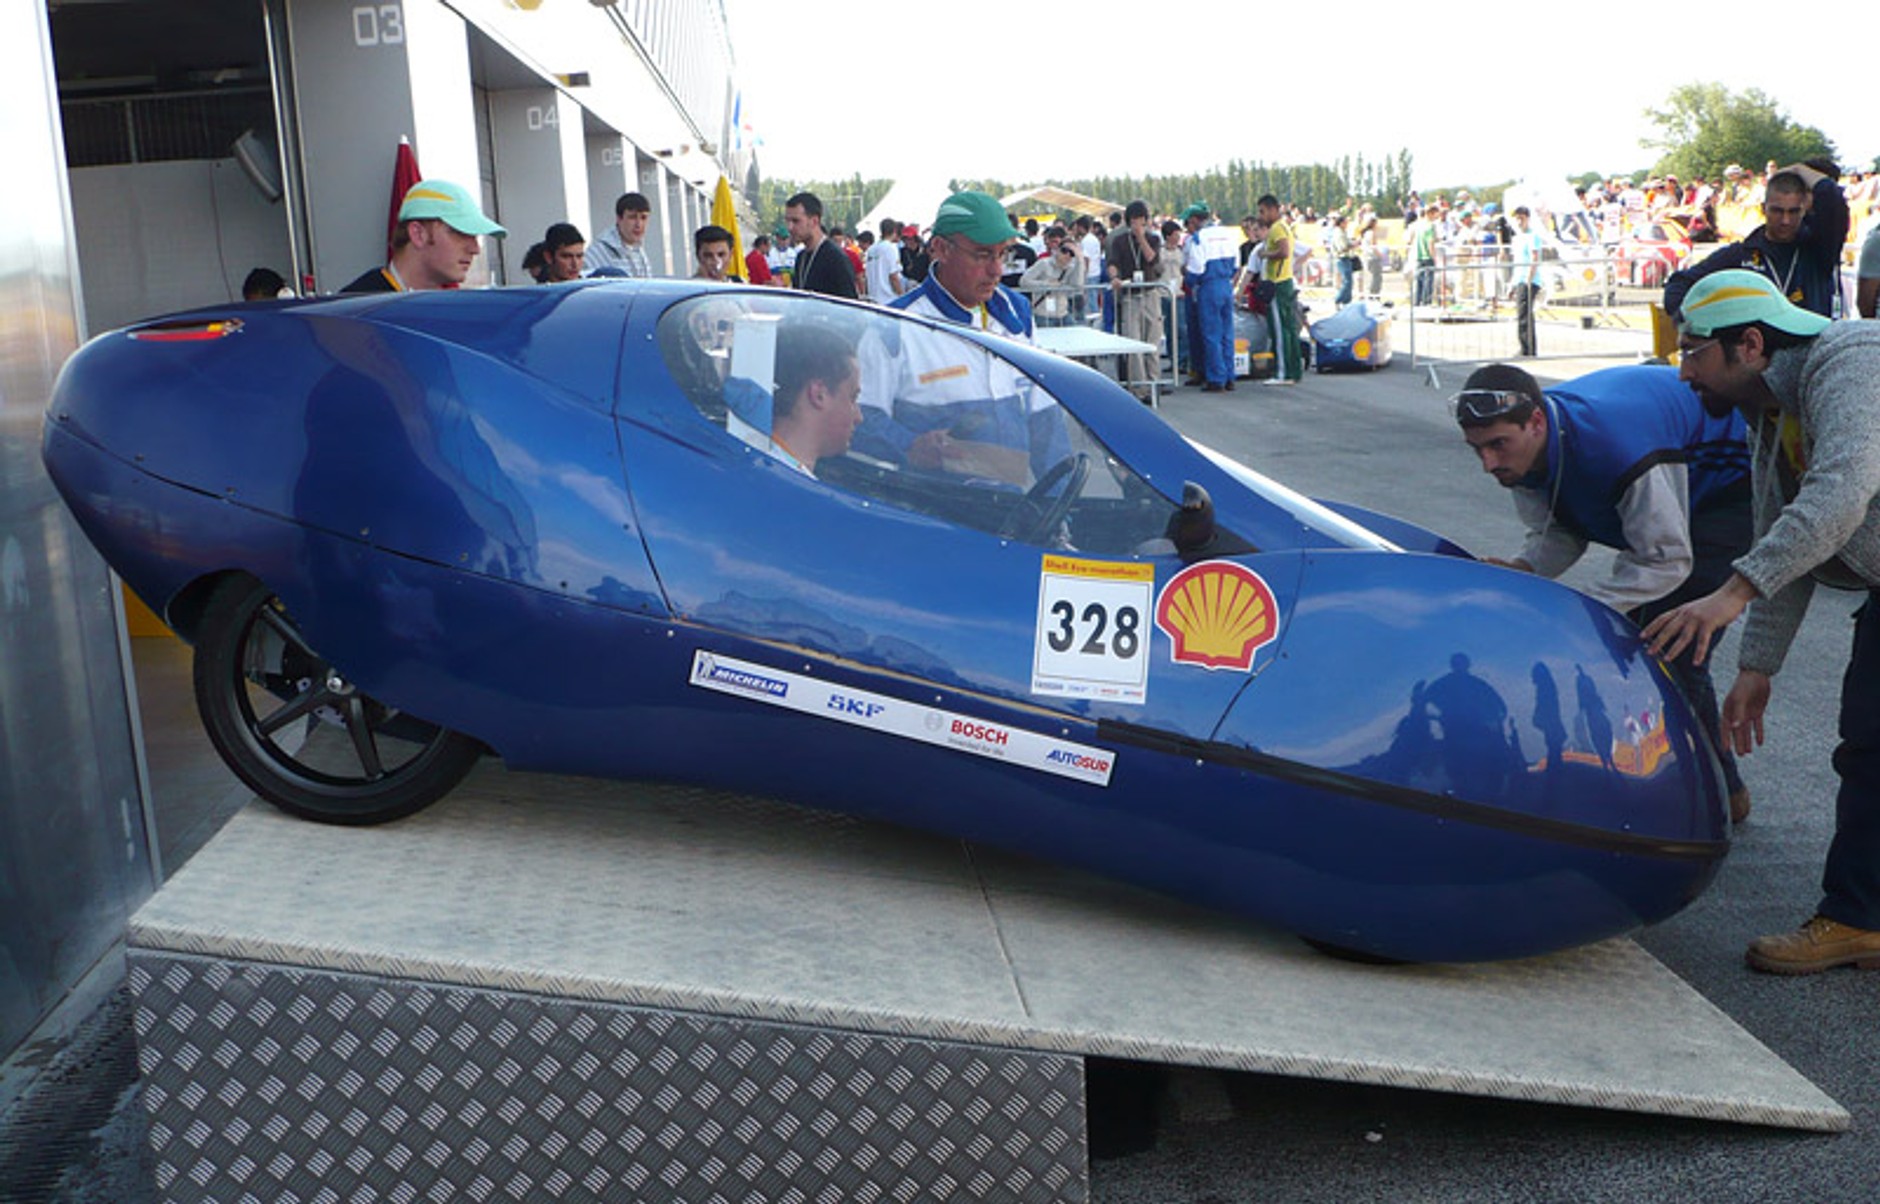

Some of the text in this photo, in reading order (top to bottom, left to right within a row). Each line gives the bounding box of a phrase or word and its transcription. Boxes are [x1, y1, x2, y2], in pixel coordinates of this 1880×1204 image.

[353, 5, 403, 46] 03
[527, 105, 560, 131] 04
[1048, 600, 1139, 660] 328
[714, 668, 786, 694] MICHELIN
[827, 694, 885, 718] SKF
[951, 719, 1009, 746] BOSCH
[1046, 749, 1110, 774] AUTOSUR
